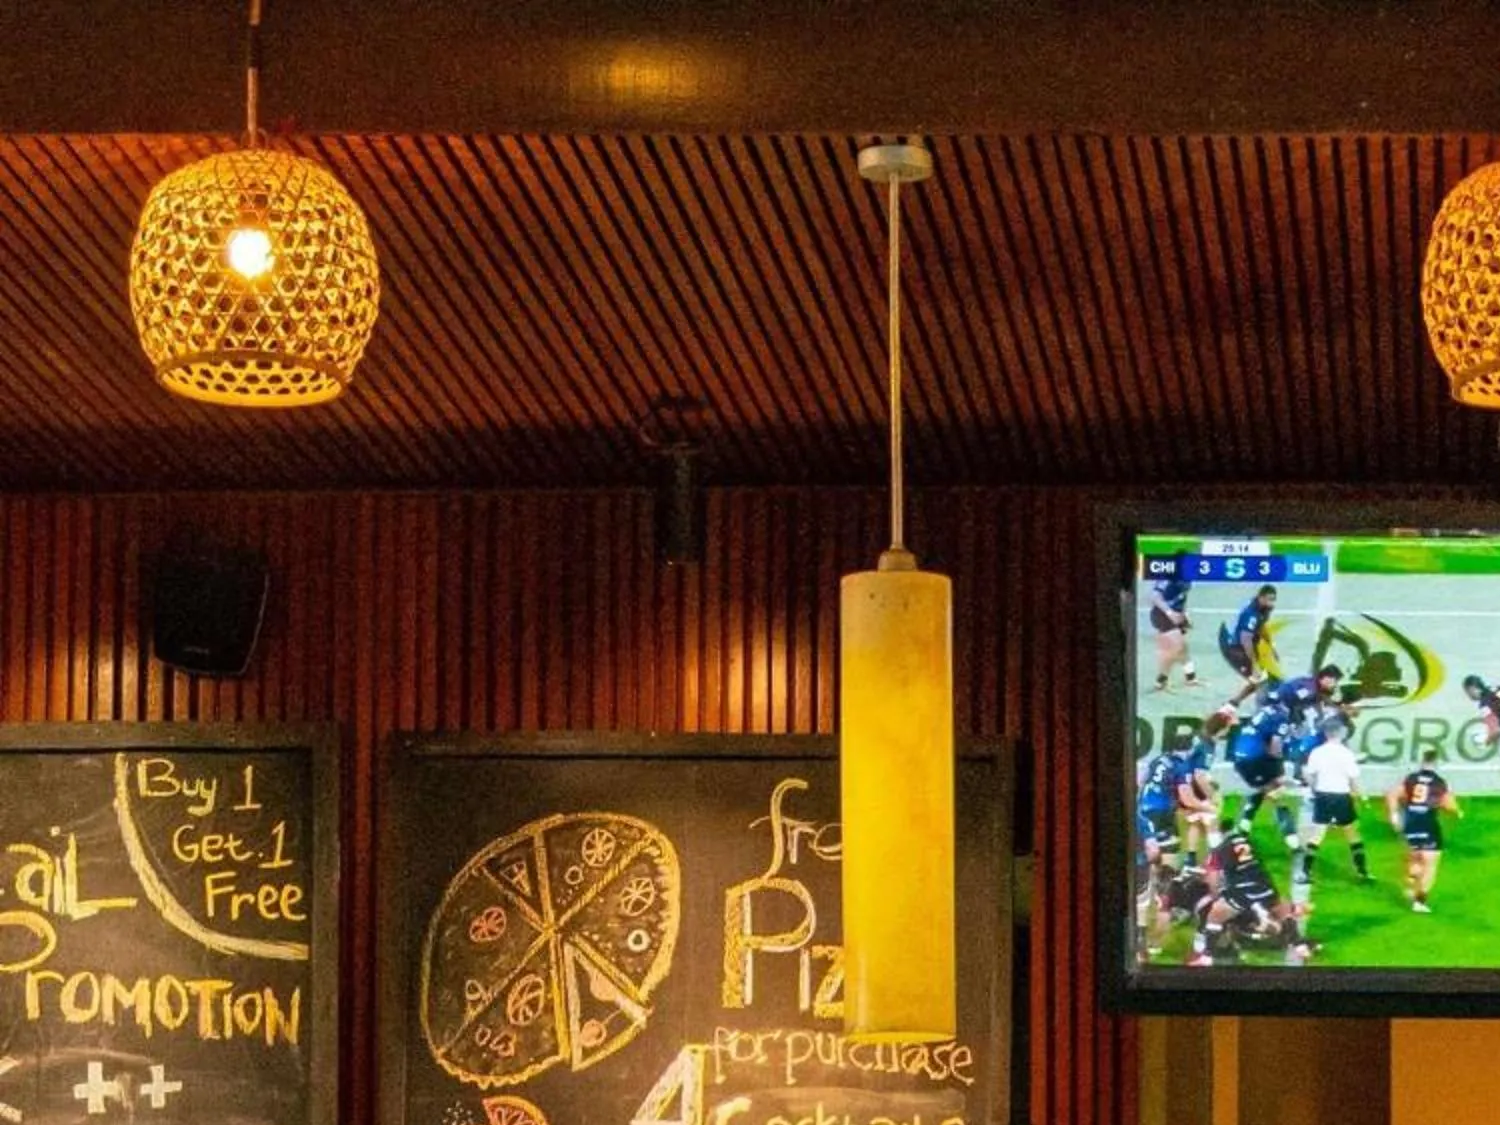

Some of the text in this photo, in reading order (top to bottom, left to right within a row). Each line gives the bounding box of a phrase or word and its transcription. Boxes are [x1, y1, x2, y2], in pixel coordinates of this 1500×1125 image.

[1150, 561, 1175, 574] CHI
[1199, 561, 1211, 575] 3
[1259, 561, 1271, 575] 3
[1292, 562, 1321, 575] BLU
[137, 758, 262, 817] Buy 1
[258, 820, 293, 869] 1
[204, 871, 307, 921] Free
[706, 1026, 782, 1085] for
